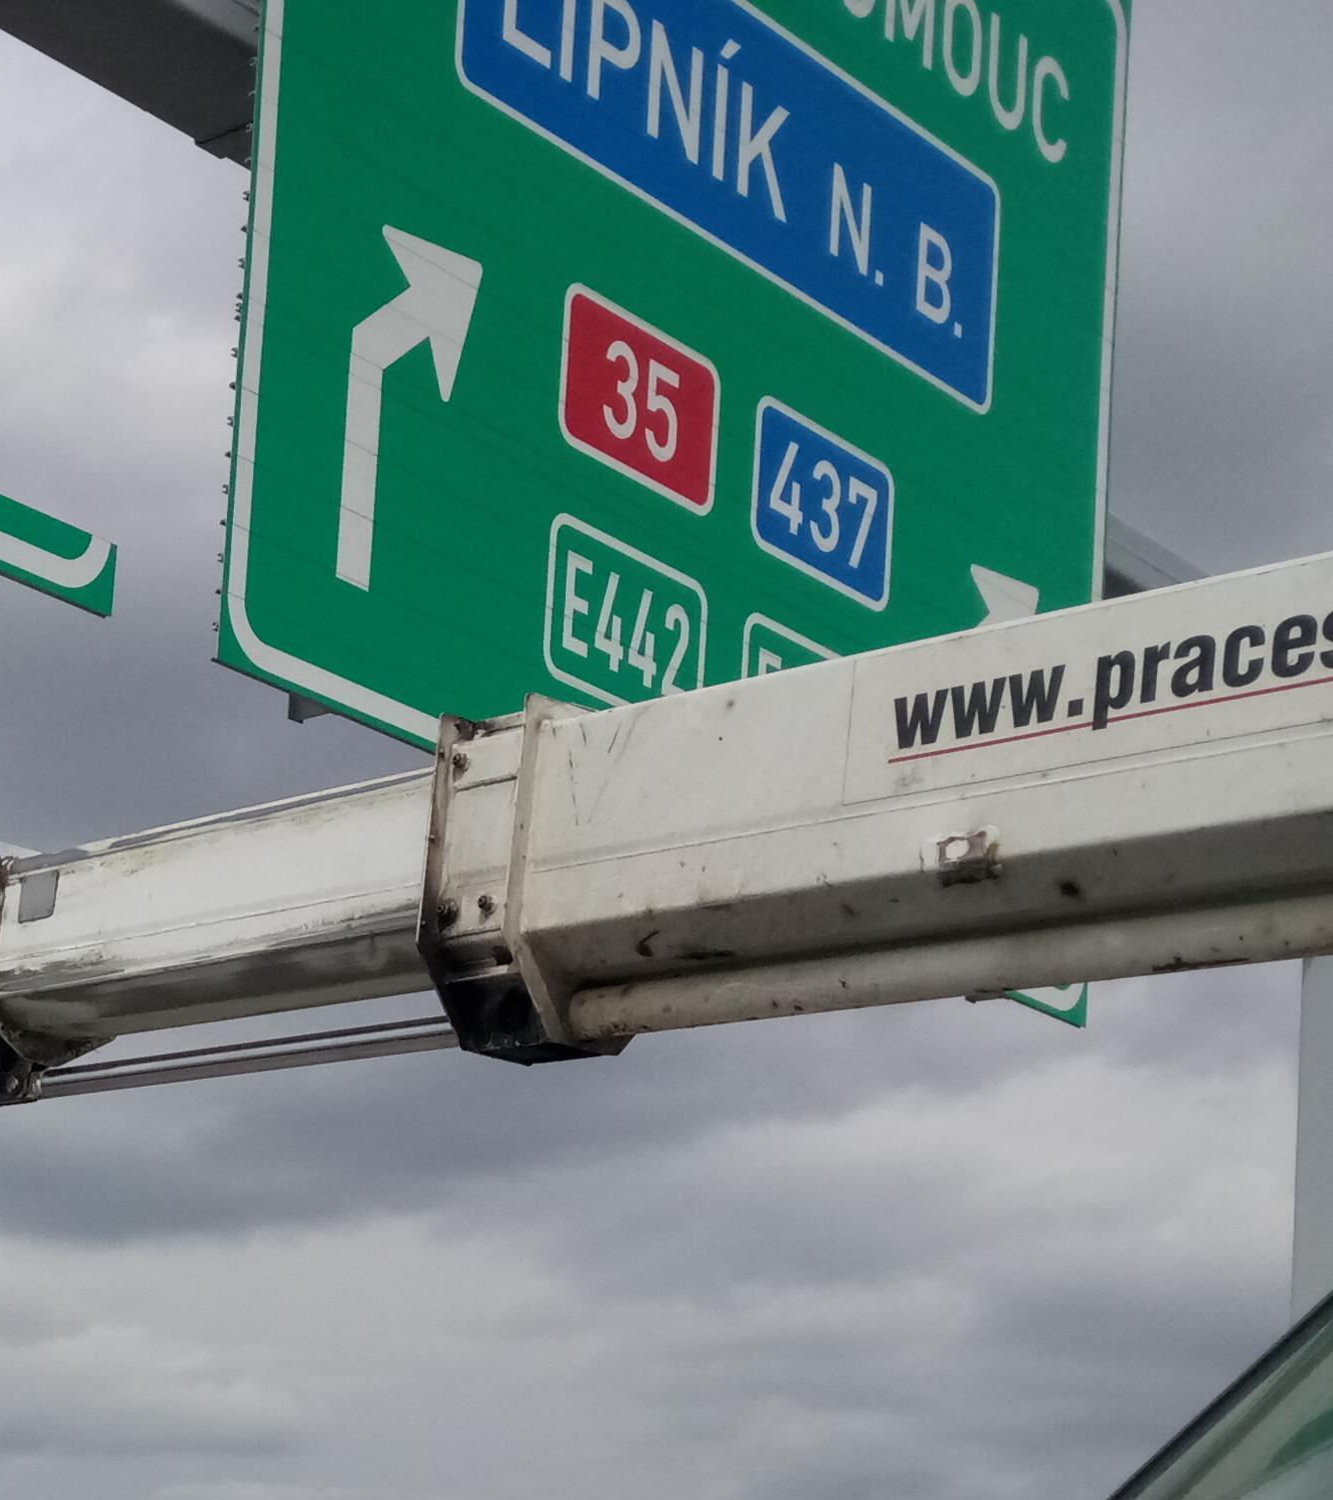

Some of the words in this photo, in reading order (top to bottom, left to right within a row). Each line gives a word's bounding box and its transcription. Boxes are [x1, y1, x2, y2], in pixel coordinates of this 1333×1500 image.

[843, 0, 1070, 164] MOUC
[830, 162, 884, 286] N.
[916, 222, 963, 339] B.
[603, 340, 680, 462] 35
[769, 441, 878, 569] 437
[562, 550, 690, 697] E442
